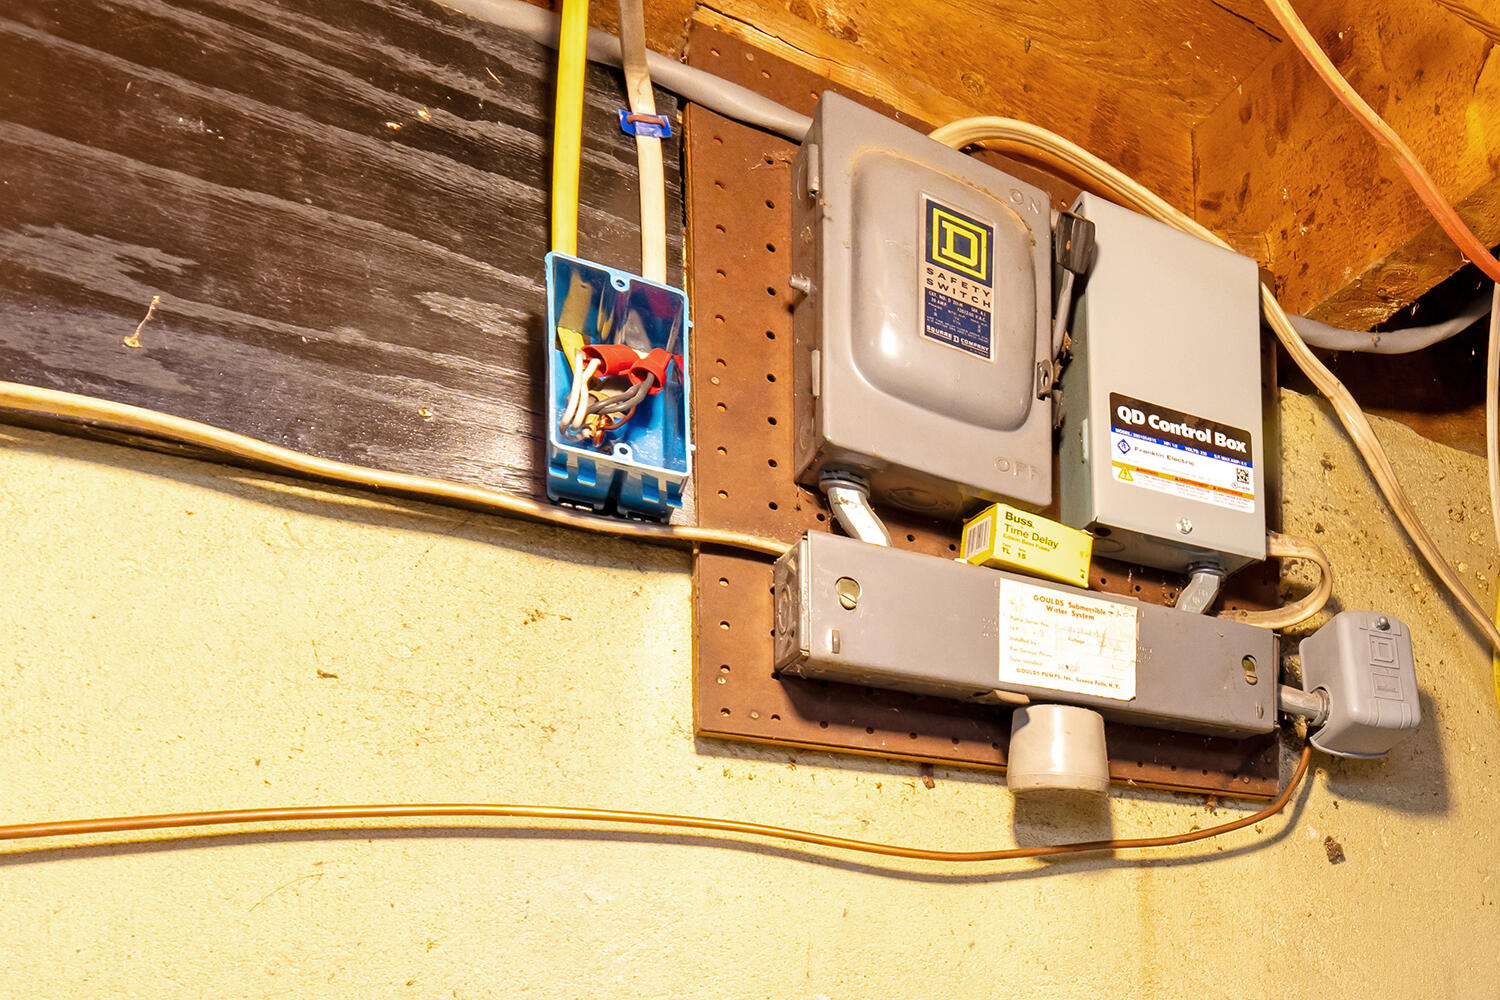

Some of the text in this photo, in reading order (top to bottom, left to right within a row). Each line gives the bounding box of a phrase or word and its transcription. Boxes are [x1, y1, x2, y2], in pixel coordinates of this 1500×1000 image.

[926, 267, 990, 297] SAFETY
[926, 278, 991, 308] SWITCH
[926, 325, 990, 352] SQUARE D COMPANY
[1117, 405, 1146, 425] QD
[1148, 414, 1212, 444] Control
[1214, 432, 1247, 453] Box
[993, 456, 1041, 481] OFF
[1134, 446, 1196, 467] Franklin Electric
[1005, 523, 1059, 549] Time Delay
[1033, 594, 1064, 606] GOULDS
[1068, 601, 1107, 616] Submersible
[1046, 604, 1068, 615] Water
[1071, 610, 1095, 621] System
[1016, 667, 1040, 677] GOULDS
